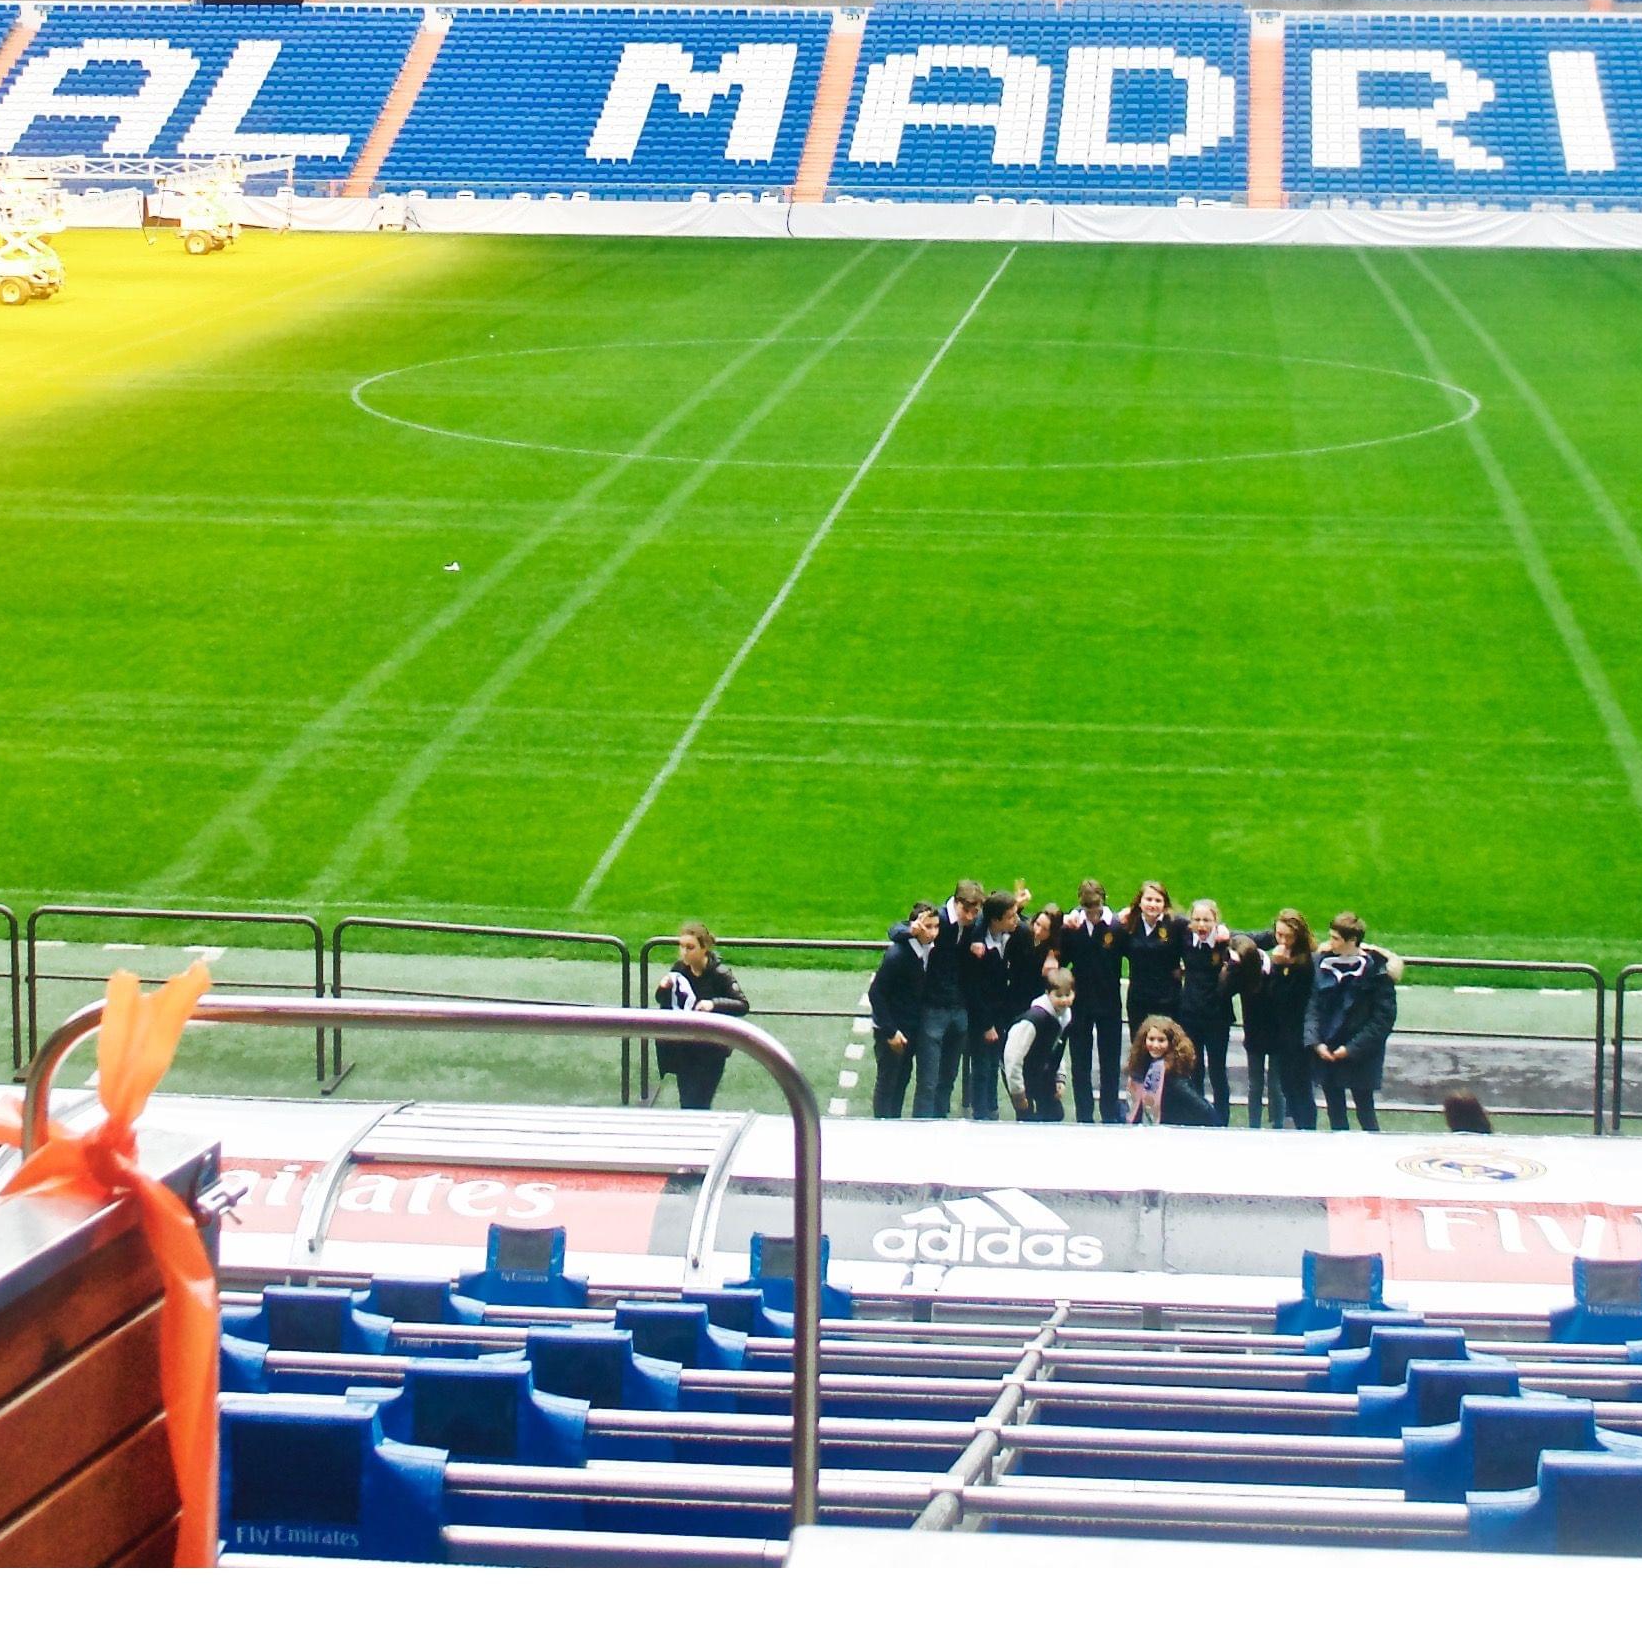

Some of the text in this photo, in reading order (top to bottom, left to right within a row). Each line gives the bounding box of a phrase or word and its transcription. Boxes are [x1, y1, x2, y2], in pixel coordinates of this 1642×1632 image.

[872, 1223, 1104, 1267] adidas
[1416, 1205, 1606, 1258] Fly
[236, 1525, 359, 1547] Fly Emirates
